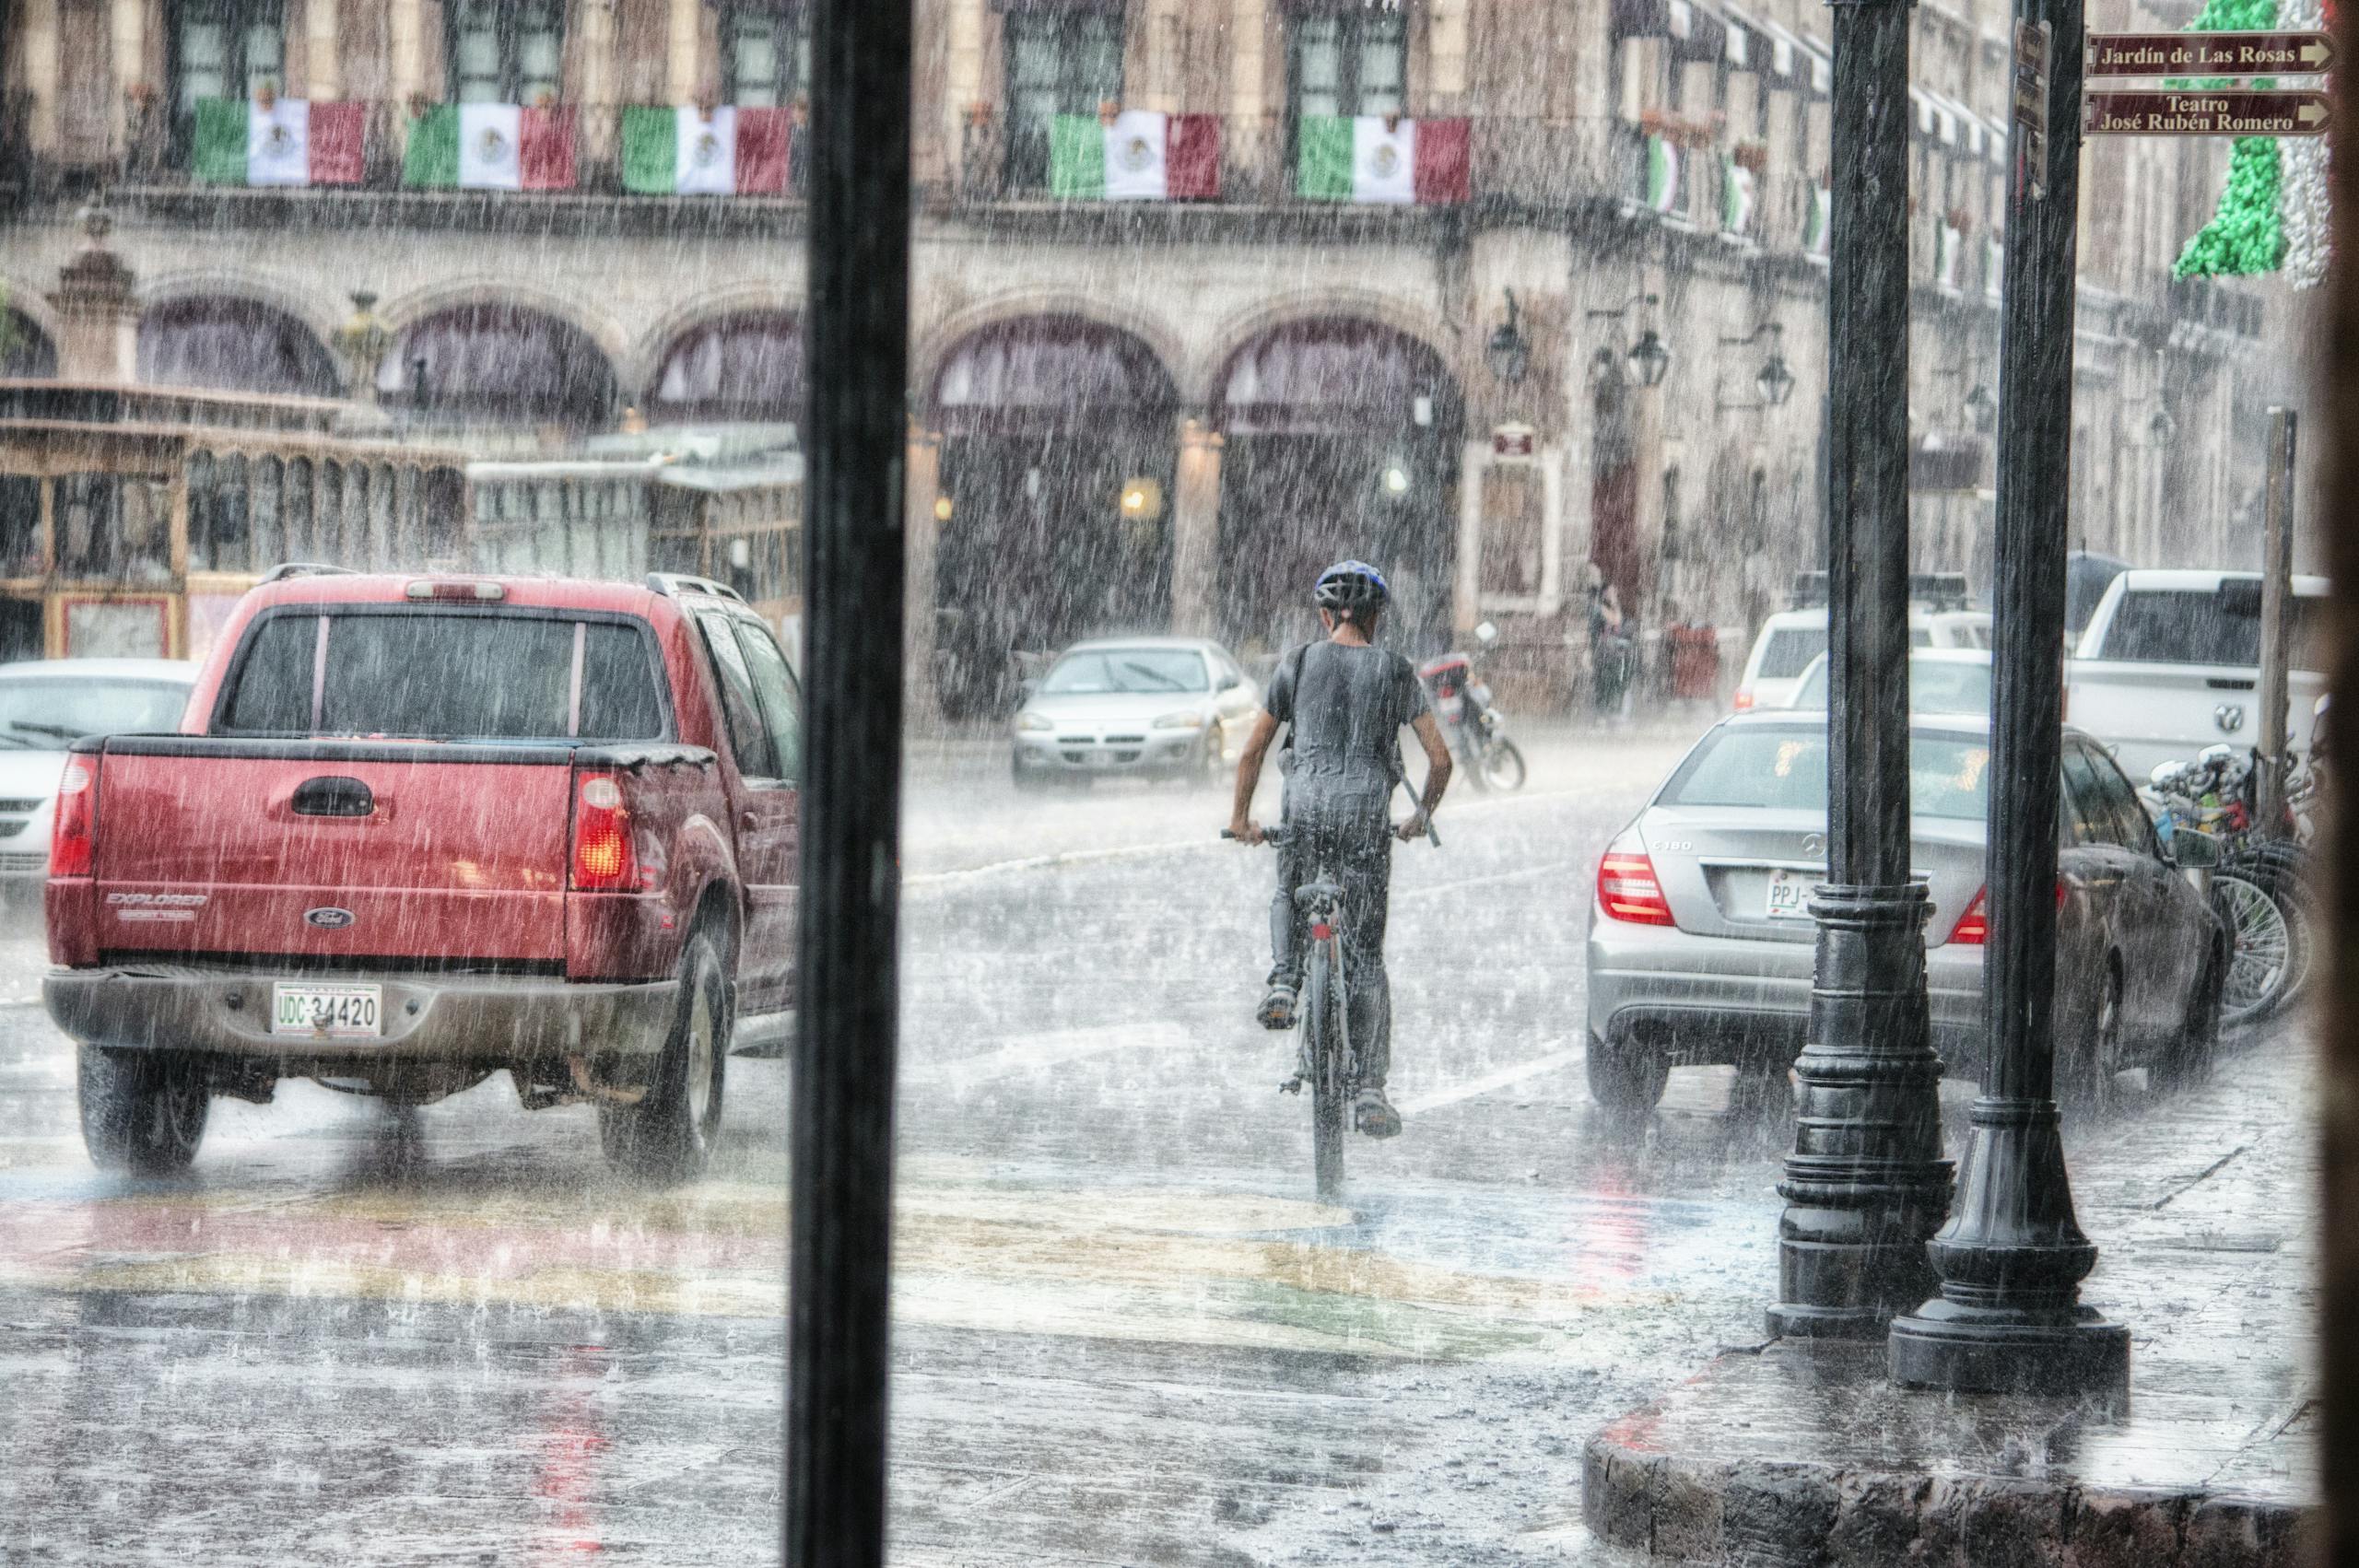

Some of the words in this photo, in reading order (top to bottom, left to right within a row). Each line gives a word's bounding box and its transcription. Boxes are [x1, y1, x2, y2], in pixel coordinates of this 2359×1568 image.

[2101, 47, 2165, 64] Jardín
[2170, 47, 2193, 64] de
[2199, 46, 2234, 64] Las
[2238, 45, 2295, 63] Rosas
[2166, 95, 2229, 112] Teatro
[2101, 113, 2142, 130] José
[2148, 113, 2211, 130] Rubén
[2217, 113, 2294, 130] Romero
[278, 996, 376, 1026] UDC-34420
